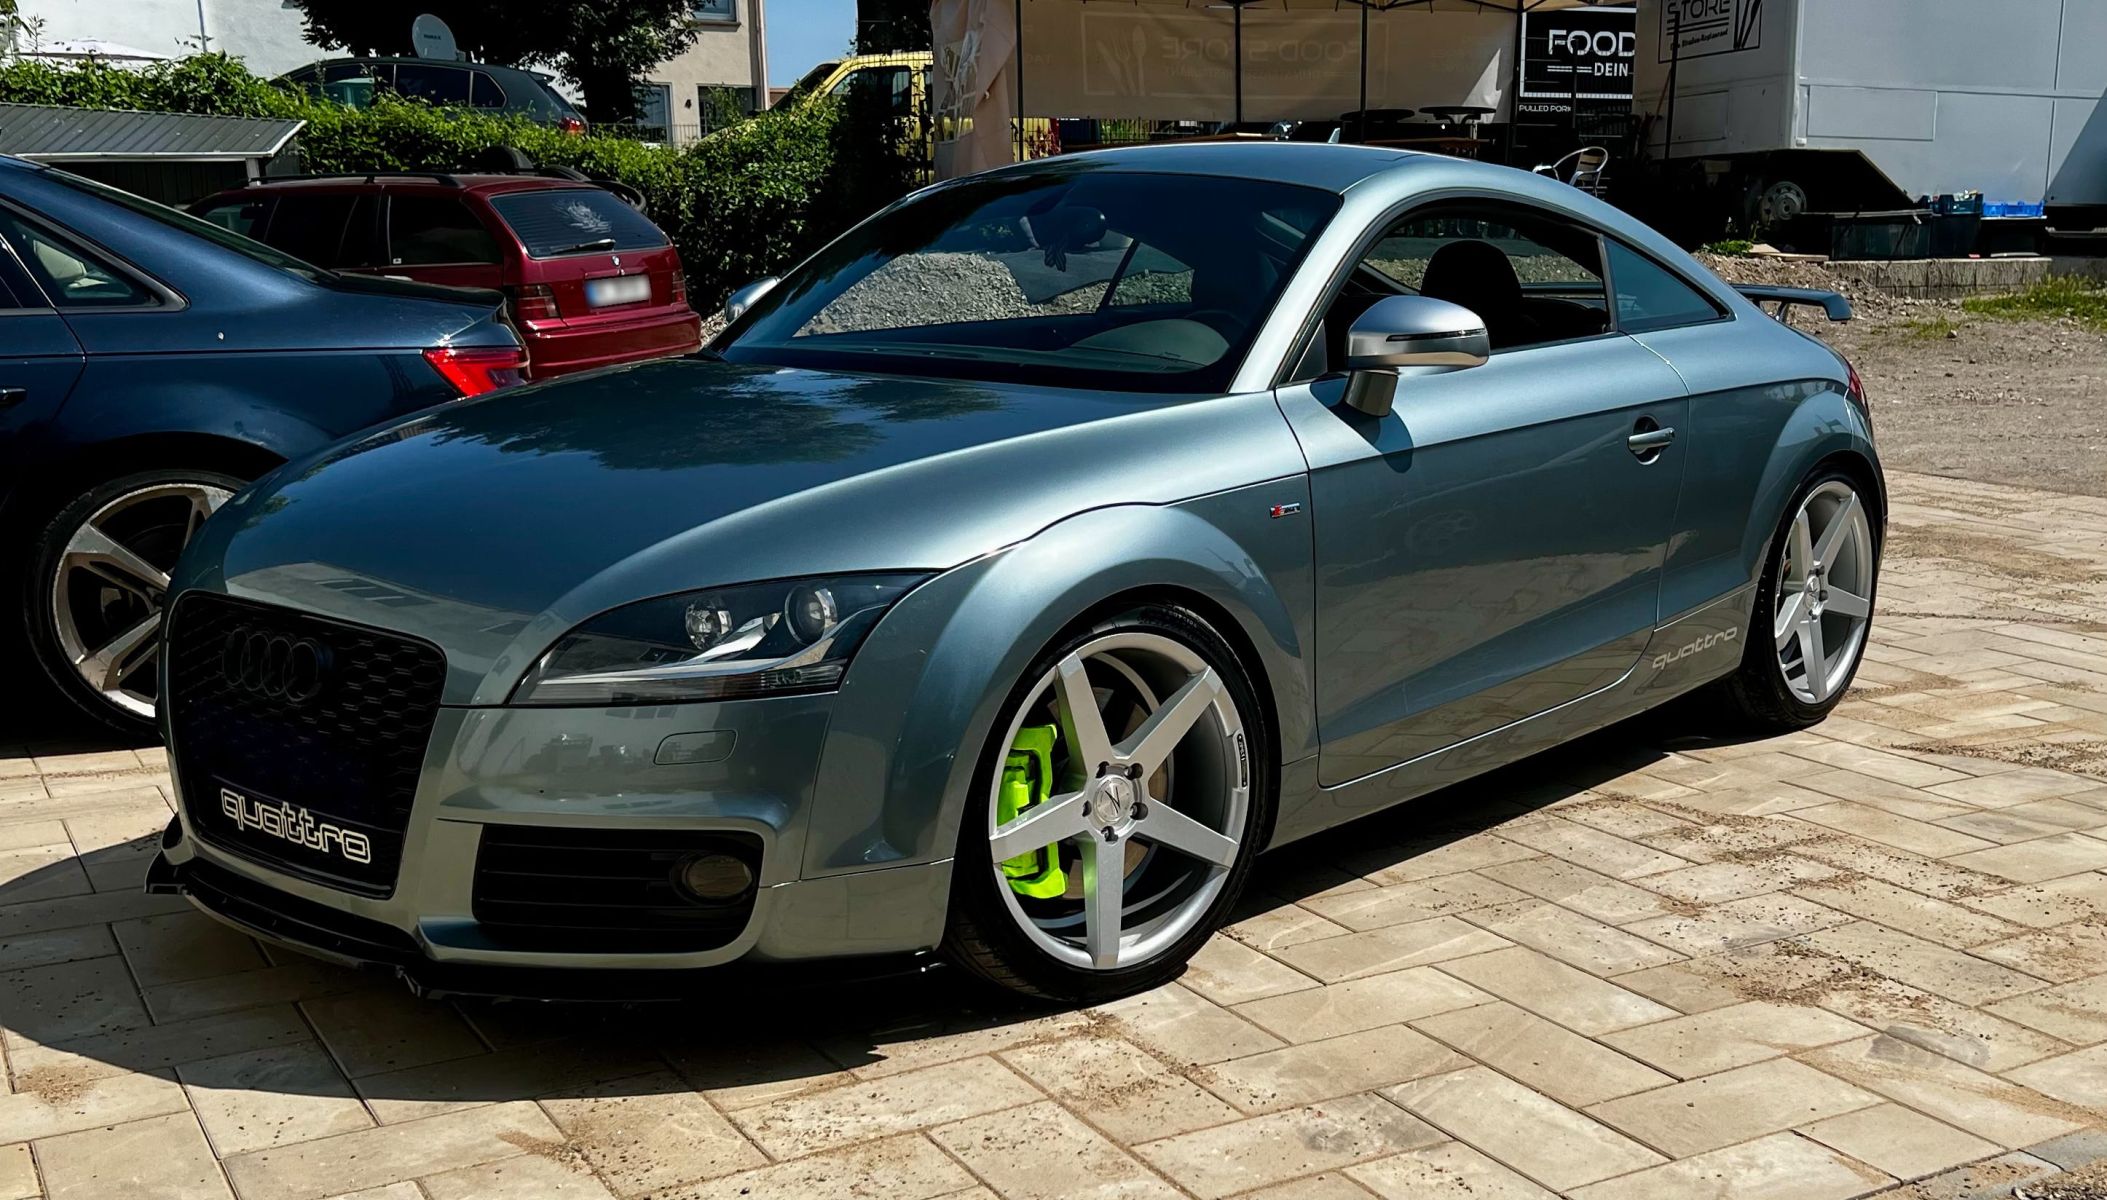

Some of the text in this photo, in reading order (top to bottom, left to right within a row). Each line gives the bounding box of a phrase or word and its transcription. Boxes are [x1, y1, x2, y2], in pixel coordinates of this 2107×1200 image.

[1667, 0, 1730, 24] STORE
[1548, 29, 1636, 57] FOOD
[1594, 62, 1628, 77] DEIN
[1519, 104, 1549, 112] PULLED
[1652, 626, 1738, 670] quattro
[221, 787, 371, 864] quattro
